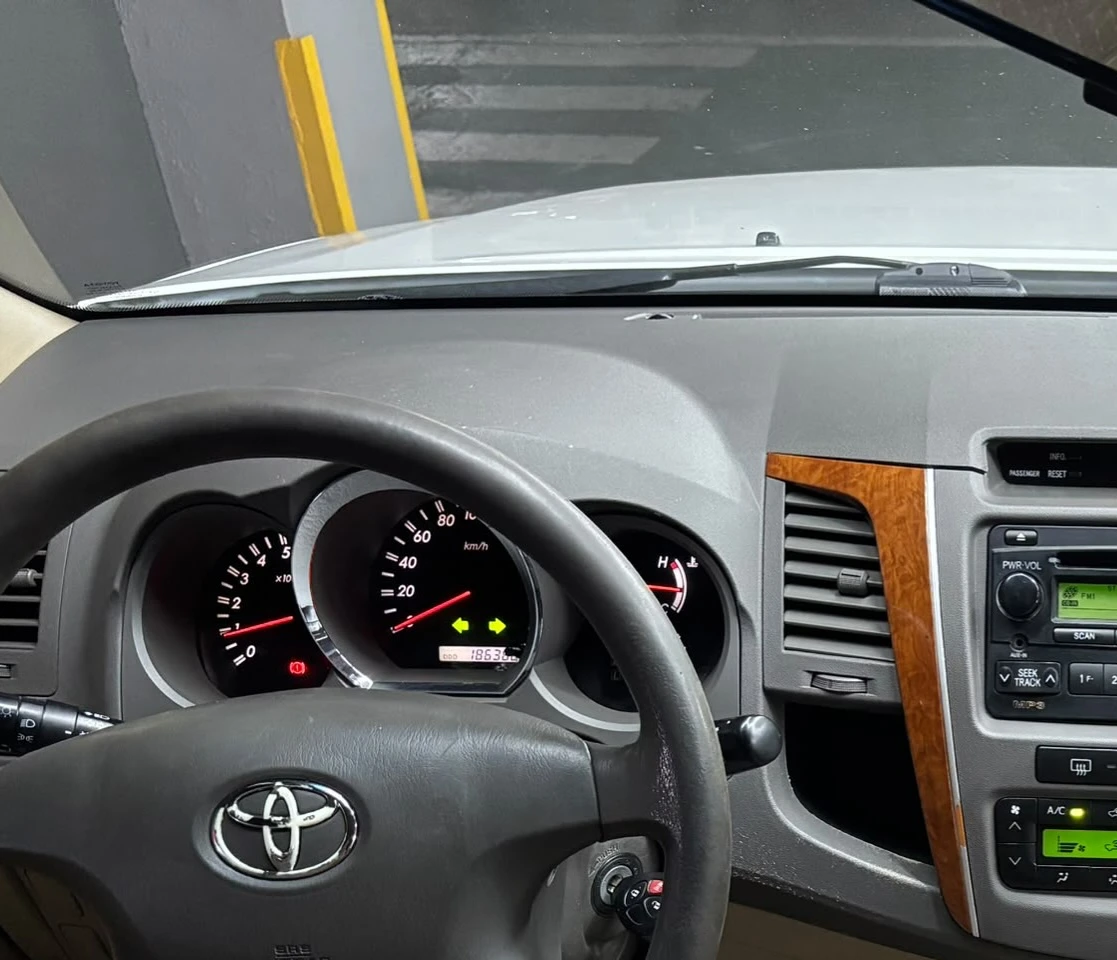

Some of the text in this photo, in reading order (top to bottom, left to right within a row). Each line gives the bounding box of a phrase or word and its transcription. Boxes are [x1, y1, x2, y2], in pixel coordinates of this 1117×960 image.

[1009, 470, 1041, 478] PASSENGER
[1048, 470, 1067, 478] RESET
[437, 514, 456, 527] 80
[413, 530, 432, 543] 60
[464, 541, 489, 551] km/h
[281, 546, 291, 559] 5
[256, 555, 267, 567] 4
[398, 556, 418, 569] 40
[657, 556, 669, 568] H
[239, 572, 250, 586] 3
[396, 585, 416, 598] 20
[231, 597, 242, 610] 2
[1073, 632, 1096, 640] SCAN
[246, 645, 256, 658] 0
[1017, 668, 1038, 678] SEEK
[1079, 674, 1084, 683] 1
[1014, 677, 1042, 687] TRACK
[1111, 676, 1117, 685] 2
[1047, 806, 1066, 815] A/C
